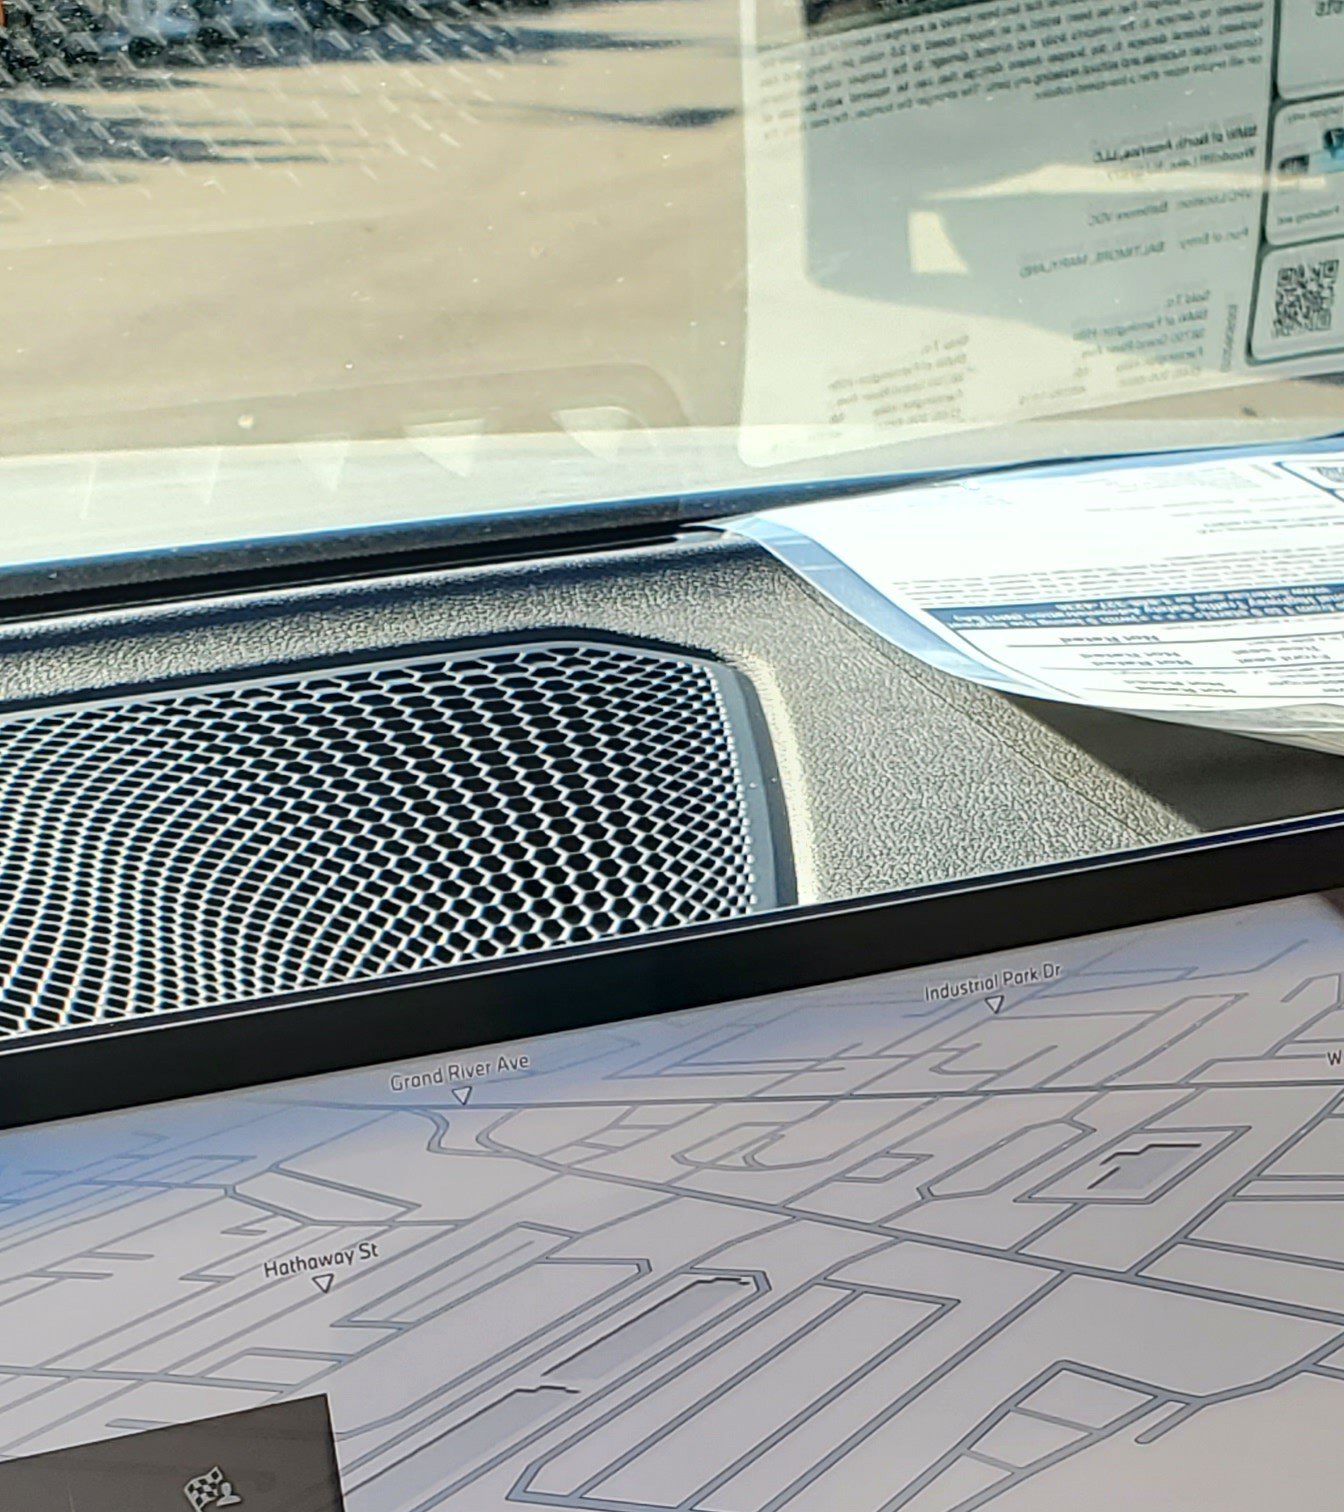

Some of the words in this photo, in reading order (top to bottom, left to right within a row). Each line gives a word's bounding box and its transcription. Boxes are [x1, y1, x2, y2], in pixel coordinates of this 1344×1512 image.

[924, 973, 999, 1003] Industrial
[1001, 966, 1041, 993] Park
[1043, 961, 1062, 981] Dr
[389, 1066, 446, 1093] Grand
[449, 1058, 493, 1084] River
[496, 1052, 531, 1078] Ave
[1326, 1047, 1344, 1068] W
[263, 1250, 355, 1279] Hathaway
[358, 1242, 380, 1261] St
